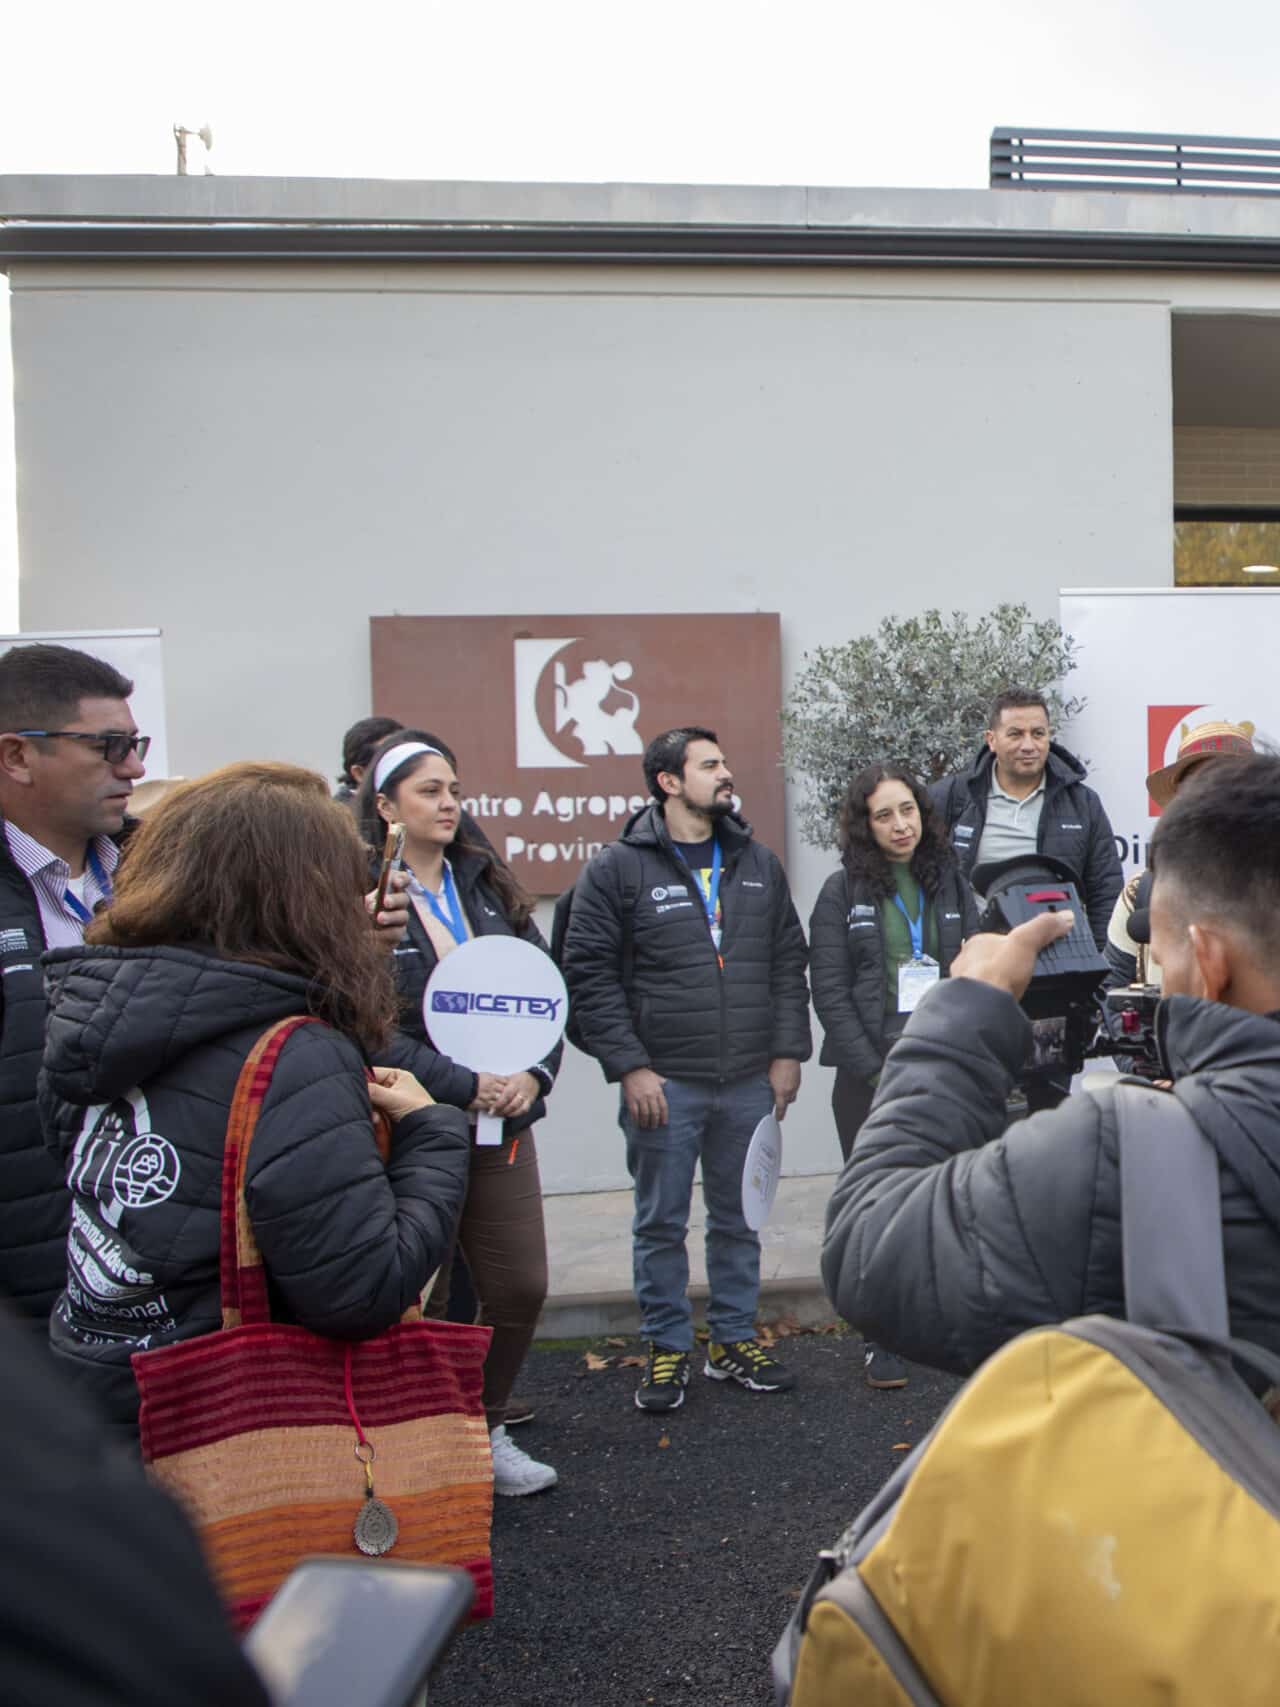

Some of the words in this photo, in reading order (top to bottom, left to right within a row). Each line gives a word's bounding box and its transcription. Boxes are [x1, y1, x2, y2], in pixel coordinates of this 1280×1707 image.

[461, 793, 522, 817] ntro
[505, 836, 603, 862] Provin
[468, 992, 562, 1021] ICETEX
